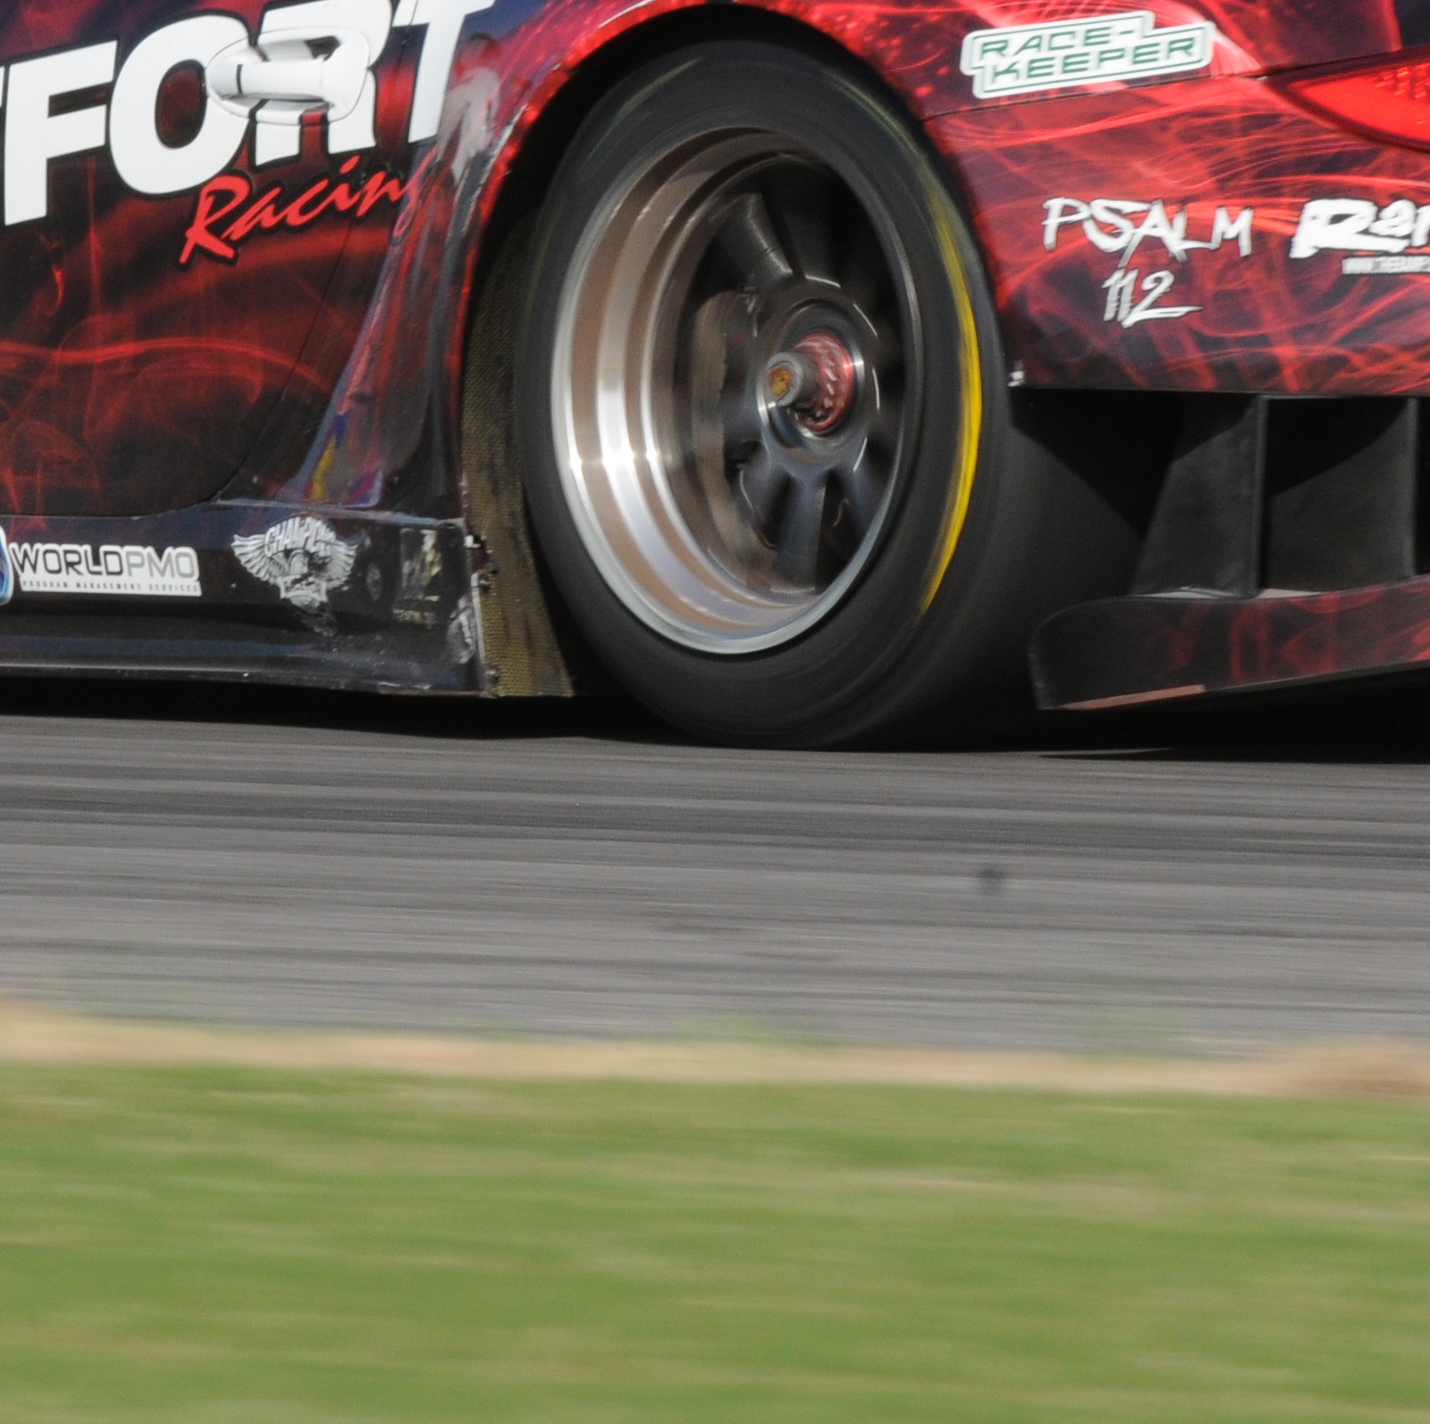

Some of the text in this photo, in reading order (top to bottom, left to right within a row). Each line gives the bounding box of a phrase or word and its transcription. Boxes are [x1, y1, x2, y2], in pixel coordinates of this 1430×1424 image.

[992, 36, 1196, 85] KEEPER
[179, 146, 437, 264] Racing
[1042, 196, 1254, 269] PSALM
[1101, 268, 1204, 329] 112
[11, 547, 196, 579] WORLDPMO
[22, 580, 69, 589] PROGRAM
[75, 580, 142, 591] MANAGEMENT
